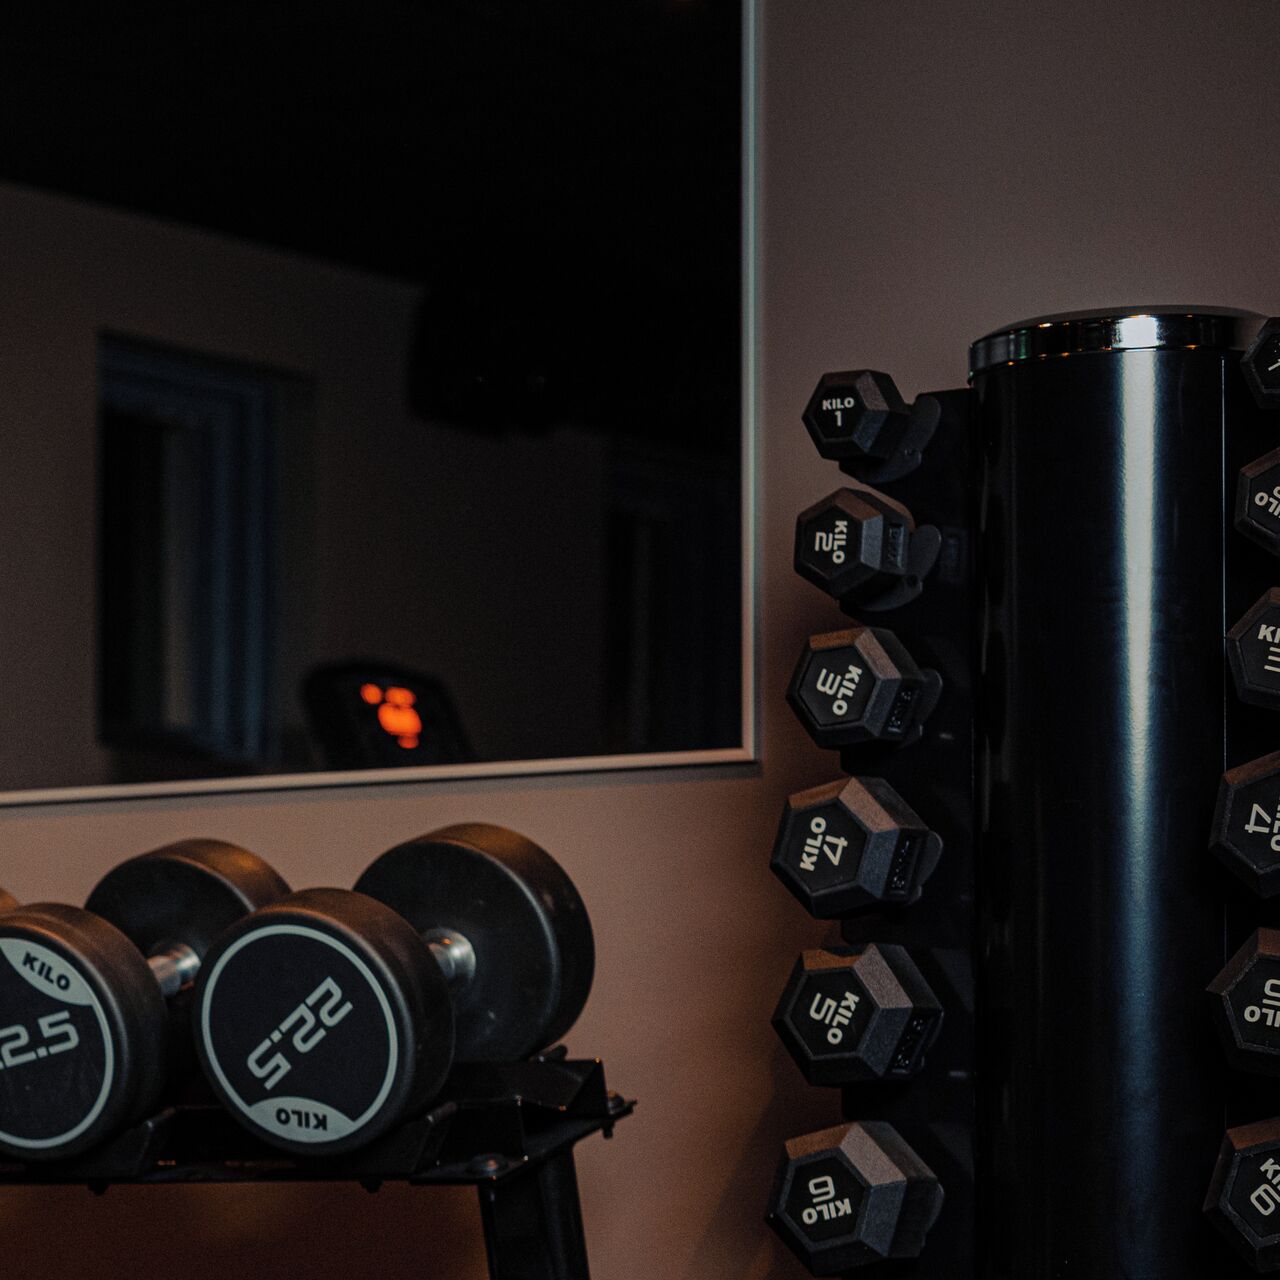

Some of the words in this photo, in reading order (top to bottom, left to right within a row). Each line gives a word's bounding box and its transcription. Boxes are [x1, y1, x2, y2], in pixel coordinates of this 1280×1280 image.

[822, 397, 855, 411] KILO
[834, 411, 842, 427] 1
[814, 532, 833, 552] 2
[833, 520, 848, 565] KILO
[816, 668, 842, 695] 3
[832, 665, 862, 716] KILO
[1244, 803, 1271, 834] 4
[800, 816, 827, 871] KILO
[822, 835, 848, 866] 4
[22, 952, 71, 991] KILO
[808, 992, 838, 1024] 5
[826, 991, 860, 1045] KILO
[1244, 1005, 1280, 1028] ILO
[247, 976, 354, 1090] 22.5
[275, 1107, 328, 1131] KILO
[802, 1197, 852, 1225] KILO
